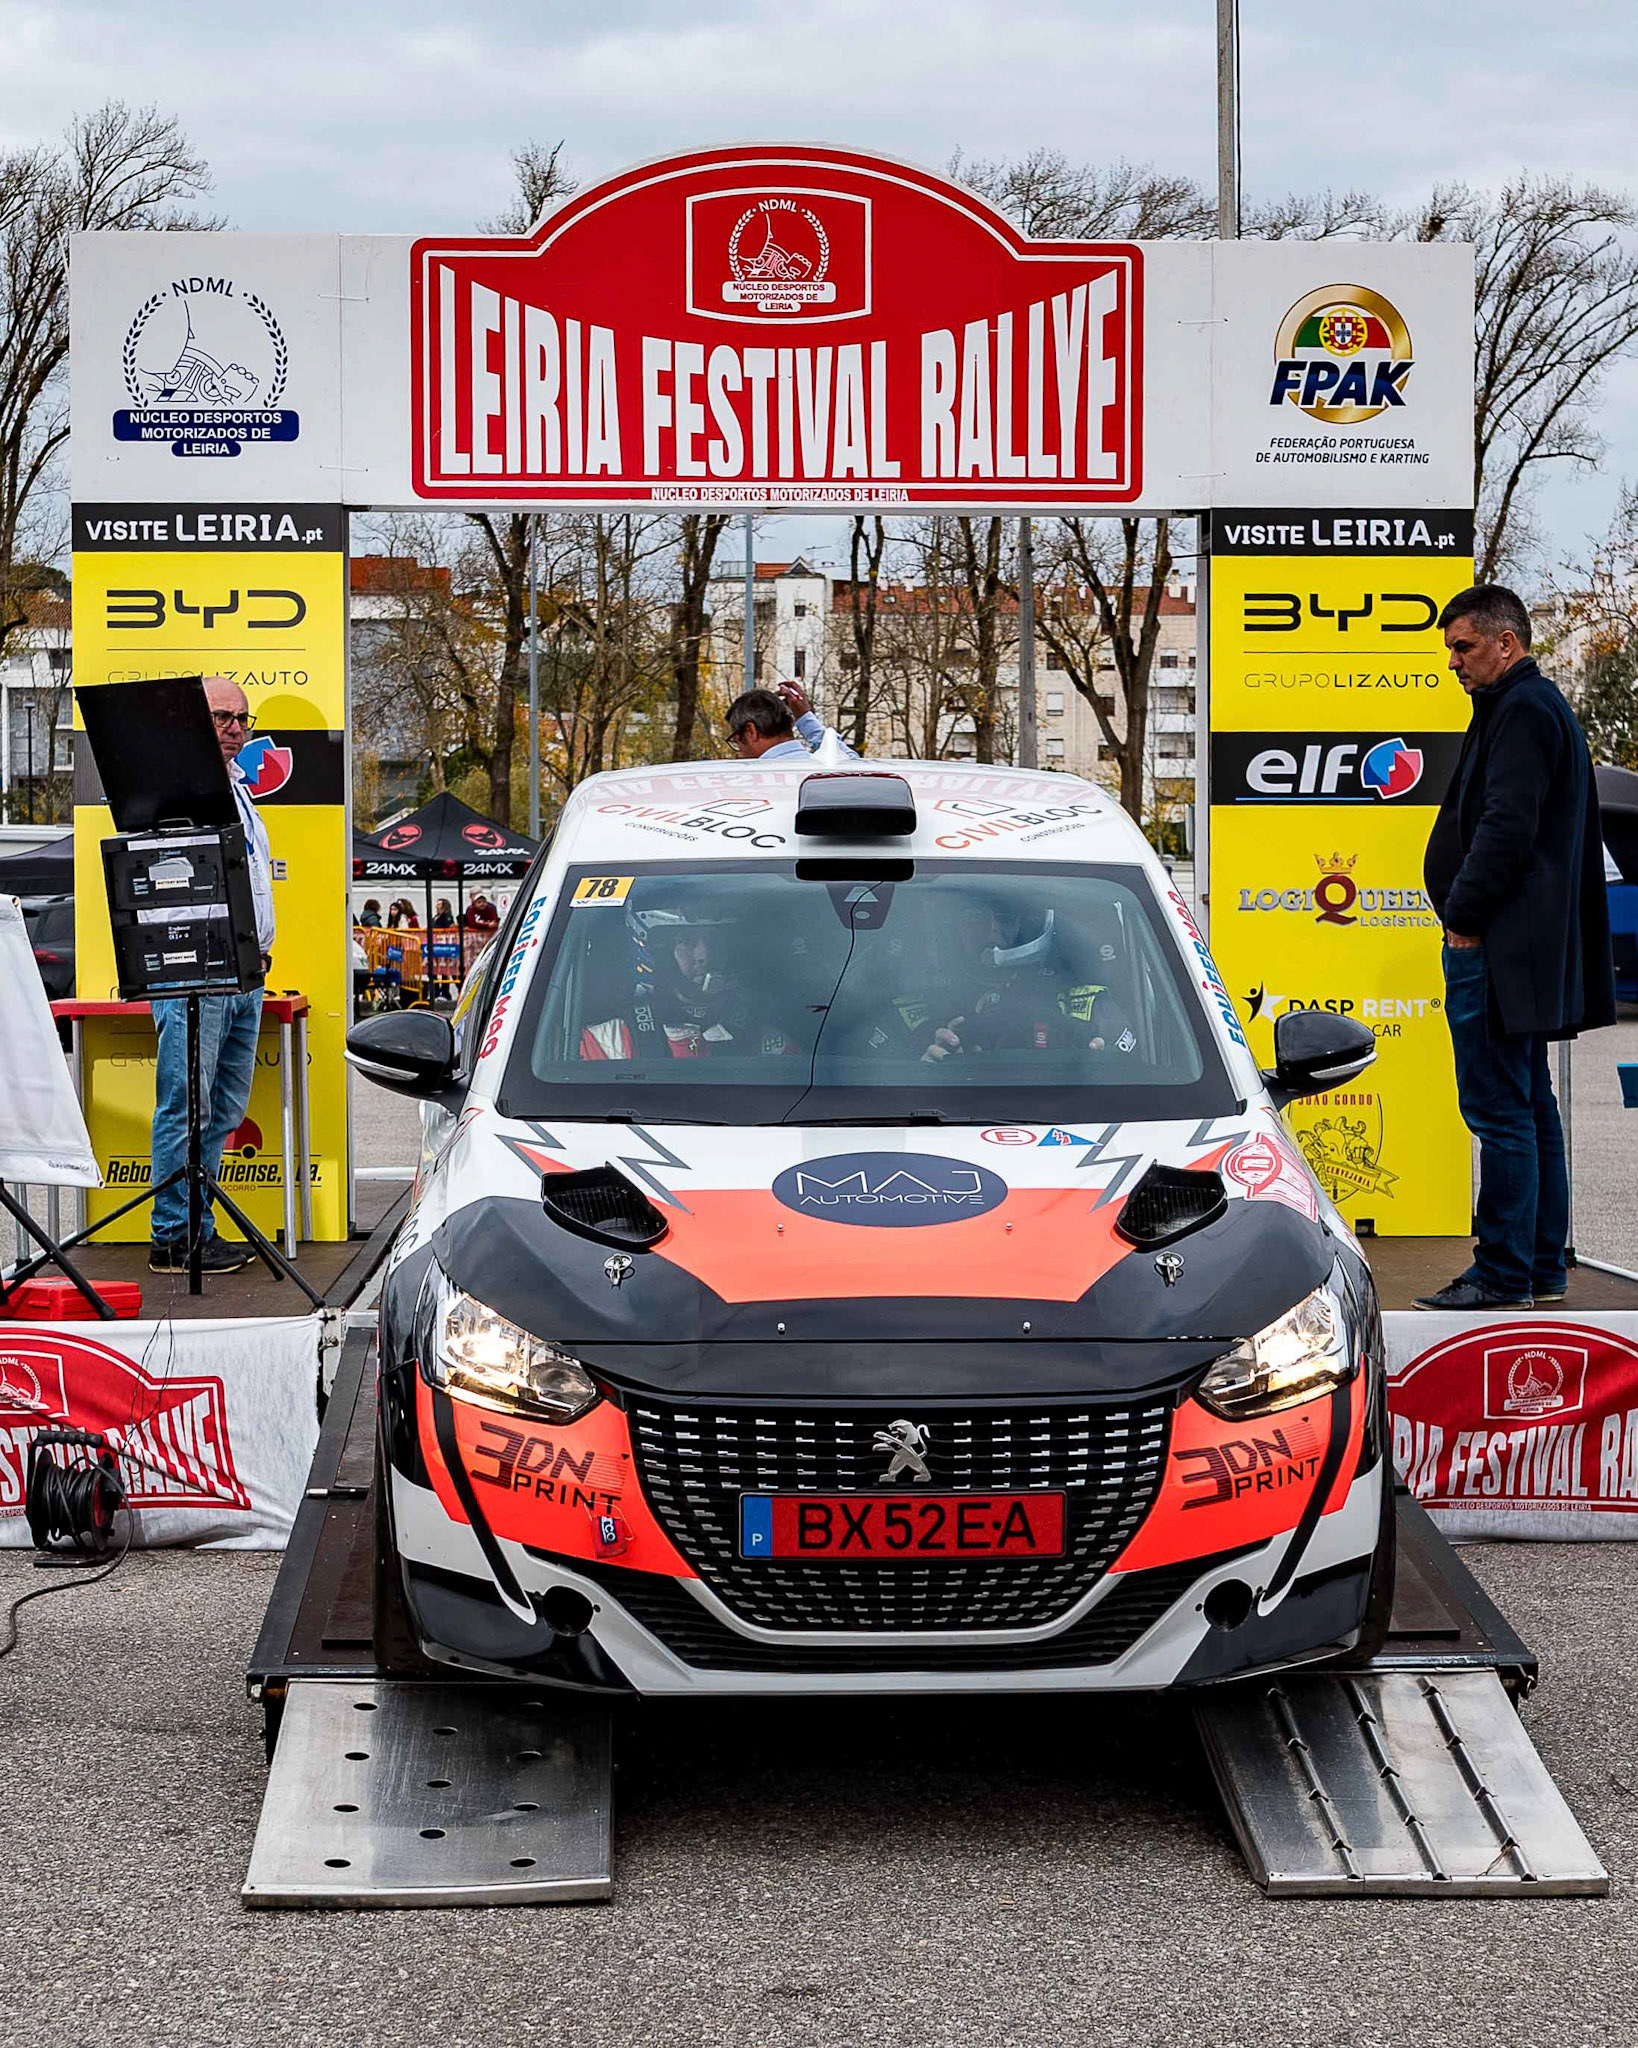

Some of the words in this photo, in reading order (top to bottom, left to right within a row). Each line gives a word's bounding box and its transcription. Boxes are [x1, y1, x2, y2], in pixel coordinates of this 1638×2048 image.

[757, 199, 797, 213] NDML
[172, 277, 233, 297] NDML
[771, 283, 825, 291] DESPORTOS
[765, 302, 793, 310] LEIRIA
[440, 264, 622, 475] LEIRIA
[642, 335, 900, 478] FESTIVAL
[921, 269, 1118, 479] RALLYE
[1270, 361, 1415, 406] FPAK
[129, 409, 190, 424] NÚCLEO
[193, 412, 283, 424] DESPORTOS
[141, 427, 248, 439] MOTORIZADOS
[251, 428, 271, 439] DE
[183, 443, 230, 455] LEIRIA
[1270, 435, 1337, 450] FEDERAÇÃO
[1339, 438, 1415, 449] PORTUGUESA
[1256, 452, 1271, 463] DE
[1273, 453, 1367, 463] AUTOMOBILISMO
[1370, 454, 1377, 463] E
[1380, 454, 1430, 464] KARTING
[700, 488, 767, 501] DESPORTOS
[770, 488, 851, 501] MOTORIZADOS
[853, 488, 868, 501] DE
[871, 488, 909, 502] LEIRIA
[86, 520, 168, 540] VISITE
[175, 514, 323, 543] LEIRIA.pt
[1224, 525, 1305, 545] VISITE
[1311, 519, 1455, 549] LEIRIA.pt
[106, 589, 307, 628] BYD
[1244, 593, 1438, 631] BYD
[1246, 744, 1358, 793] elf
[597, 804, 786, 849] CIVILBLOC
[935, 805, 1102, 849] CIVILBLOC
[366, 863, 417, 875] 24MX
[463, 862, 514, 875] 24MX
[585, 878, 619, 898] 78
[1372, 1024, 1401, 1037] CAR
[1334, 1094, 1373, 1106] GORDO
[221, 1184, 257, 1192] OCORRO
[796, 1170, 983, 1195] MAJ
[800, 1193, 985, 1205] AUTOMOTIVE
[1446, 1421, 1588, 1497] FESTIVAL
[1235, 1456, 1321, 1498] PRINT
[514, 1472, 622, 1515] PRINT
[752, 1533, 763, 1547] P
